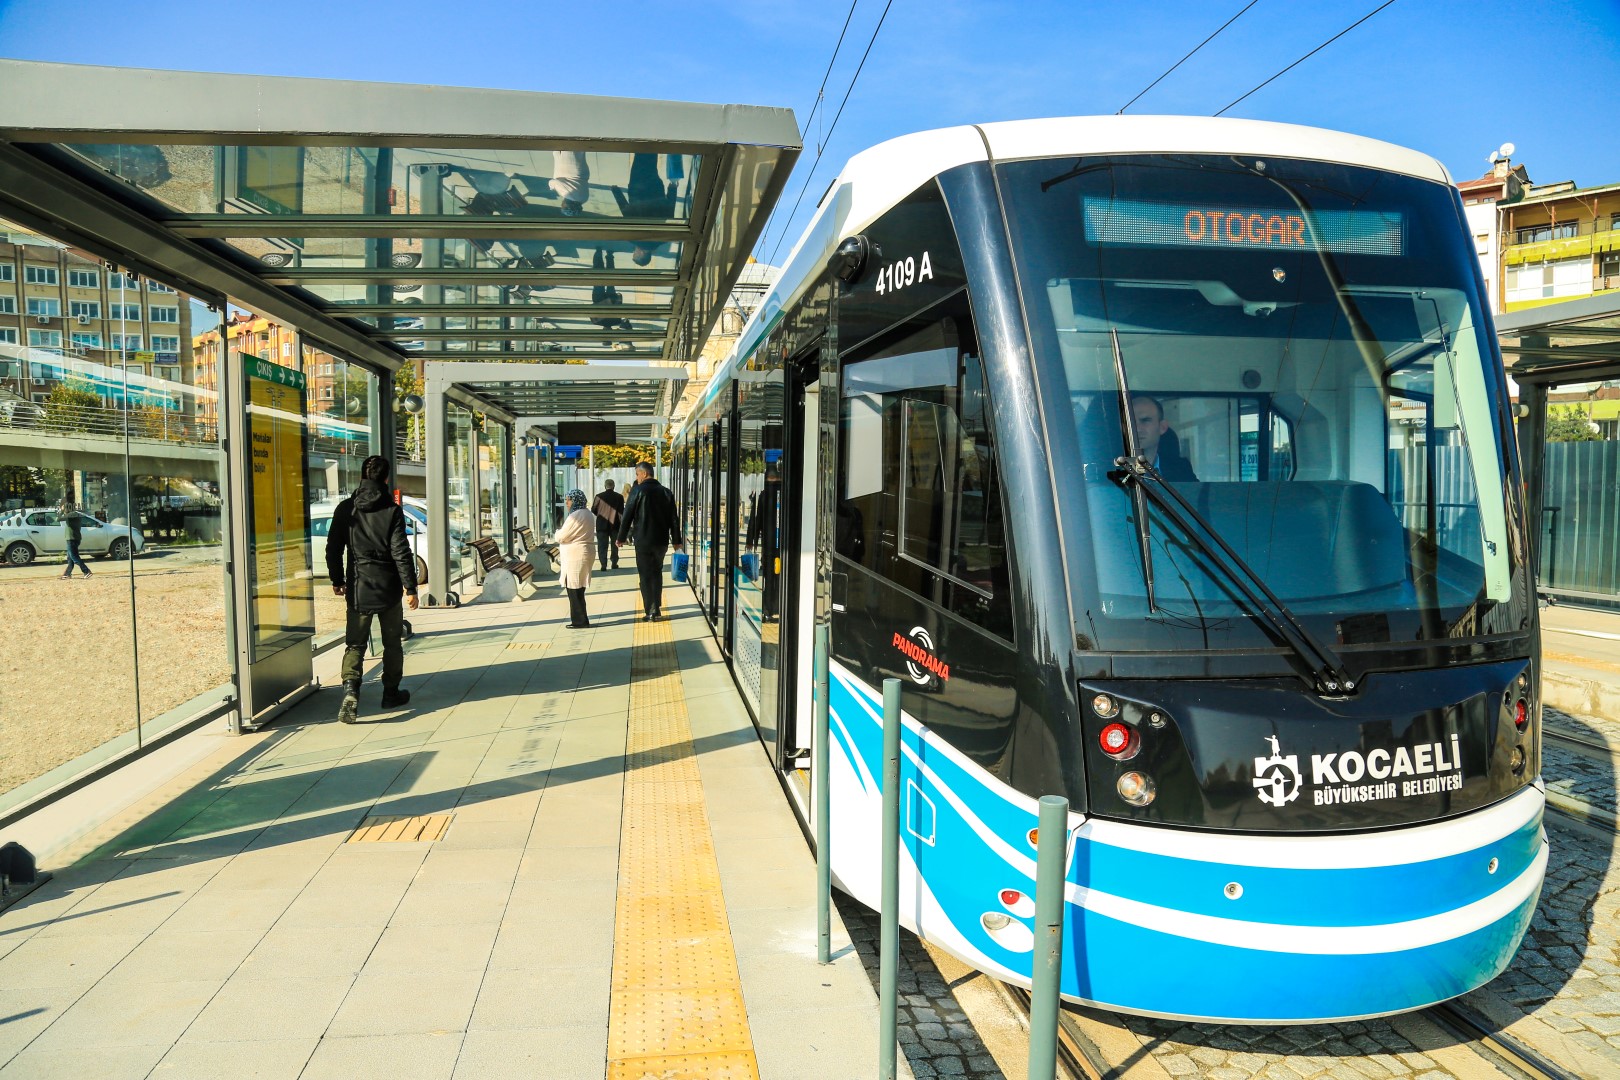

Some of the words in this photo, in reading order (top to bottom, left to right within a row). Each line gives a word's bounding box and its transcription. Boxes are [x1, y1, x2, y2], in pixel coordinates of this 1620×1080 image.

[1184, 210, 1306, 245] OTOGAR
[875, 256, 915, 296] 4109
[918, 250, 934, 283] A
[256, 361, 273, 381] ÇIKIŞ
[892, 632, 949, 682] PANORAMA
[1311, 733, 1462, 785] KOCAELİ
[1313, 780, 1397, 806] BÜYÜKŞEHİR
[1402, 771, 1463, 797] BELEDİYESİ
